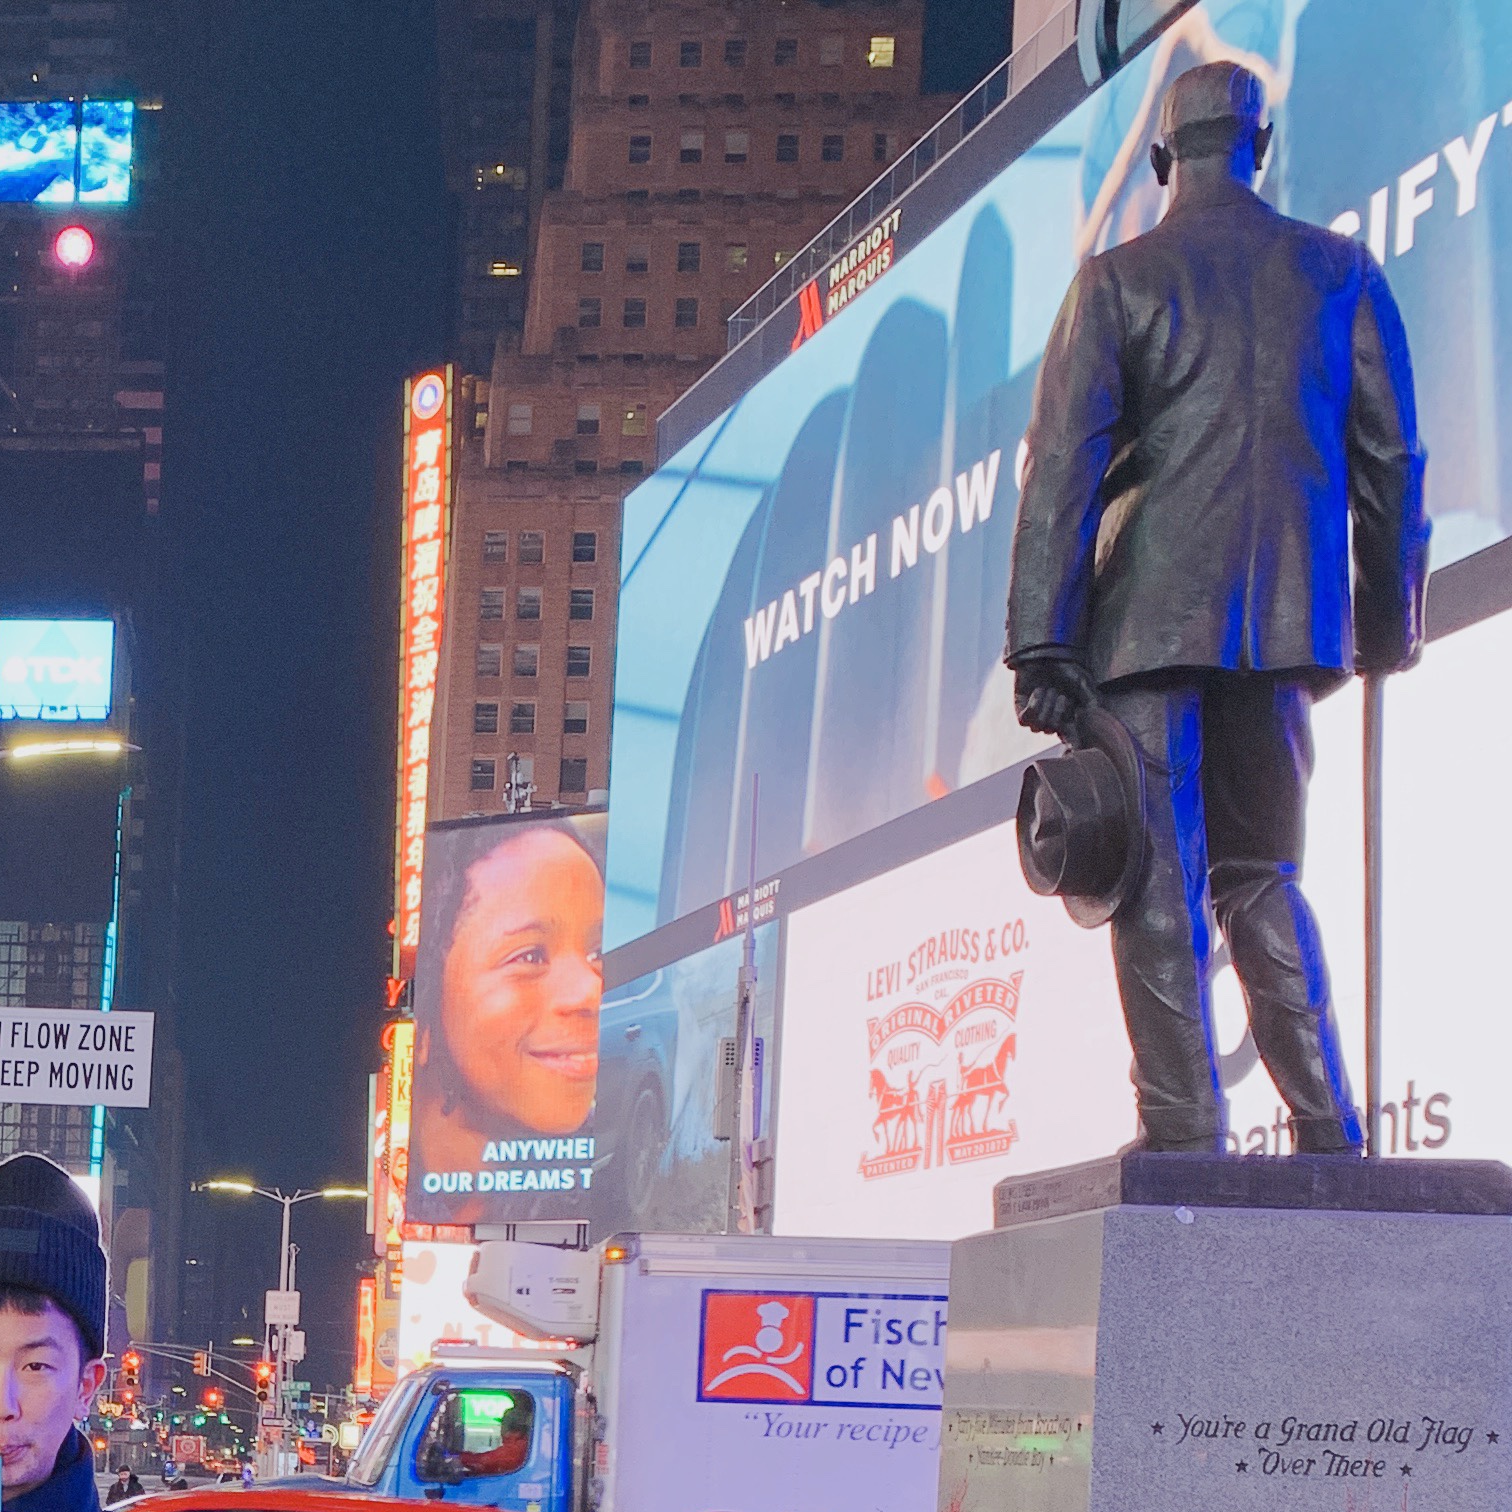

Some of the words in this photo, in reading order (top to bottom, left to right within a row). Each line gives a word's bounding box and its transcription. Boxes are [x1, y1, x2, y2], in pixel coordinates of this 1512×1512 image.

[829, 208, 902, 288] MARRIOTT
[827, 247, 891, 315] MARQUIS
[743, 532, 878, 670] WATCH
[890, 448, 1002, 579] NOW
[27, 655, 104, 685] TDK
[737, 878, 781, 910] MARIOTT
[736, 899, 775, 928] MAQUIS
[867, 960, 901, 1002] LEVI
[907, 928, 980, 986] STRAUSS
[985, 928, 996, 962] &
[1001, 918, 1030, 956] CO.
[915, 981, 929, 995] SAN
[930, 969, 969, 987] FRANCISCO
[870, 1006, 939, 1050] ORIGINAL
[944, 985, 1016, 1027] RIVETED
[10, 1022, 70, 1050] FLOW
[78, 1024, 136, 1052] ZONE
[954, 1019, 997, 1049] CLOTHING
[887, 1042, 921, 1070] QUALITY
[49, 1062, 134, 1091] MOVING
[482, 1137, 595, 1162] ANYWHE
[423, 1171, 473, 1195] OUR
[477, 1168, 575, 1192] DREAMS
[866, 1157, 913, 1177] PATENTED
[826, 1357, 867, 1389] of
[836, 1418, 929, 1450] recipe
[1175, 1413, 1246, 1446] You're
[1254, 1422, 1270, 1440] a
[1276, 1416, 1358, 1447] Grand
[1366, 1418, 1411, 1445] Old
[1416, 1416, 1475, 1453] Flag
[1257, 1447, 1316, 1477] Over
[1322, 1449, 1387, 1478] There
